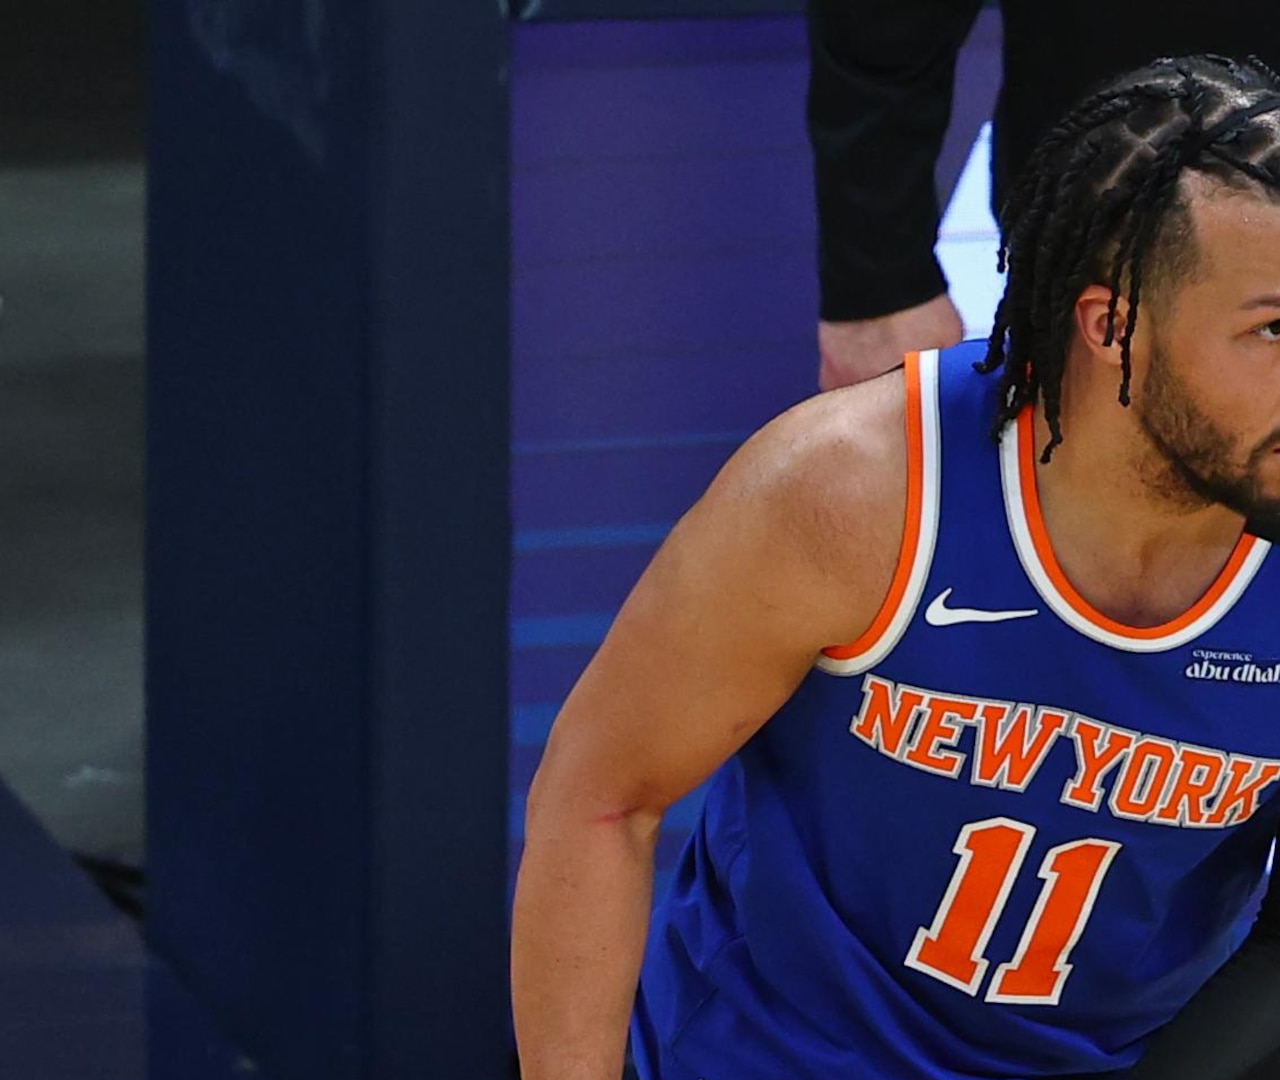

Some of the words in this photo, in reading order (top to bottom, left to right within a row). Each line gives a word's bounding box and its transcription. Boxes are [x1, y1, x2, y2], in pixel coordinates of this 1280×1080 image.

[1186, 661, 1230, 681] abu
[1193, 650, 1252, 661] experience
[850, 674, 1073, 792] NEW
[904, 816, 1123, 1006] 11
